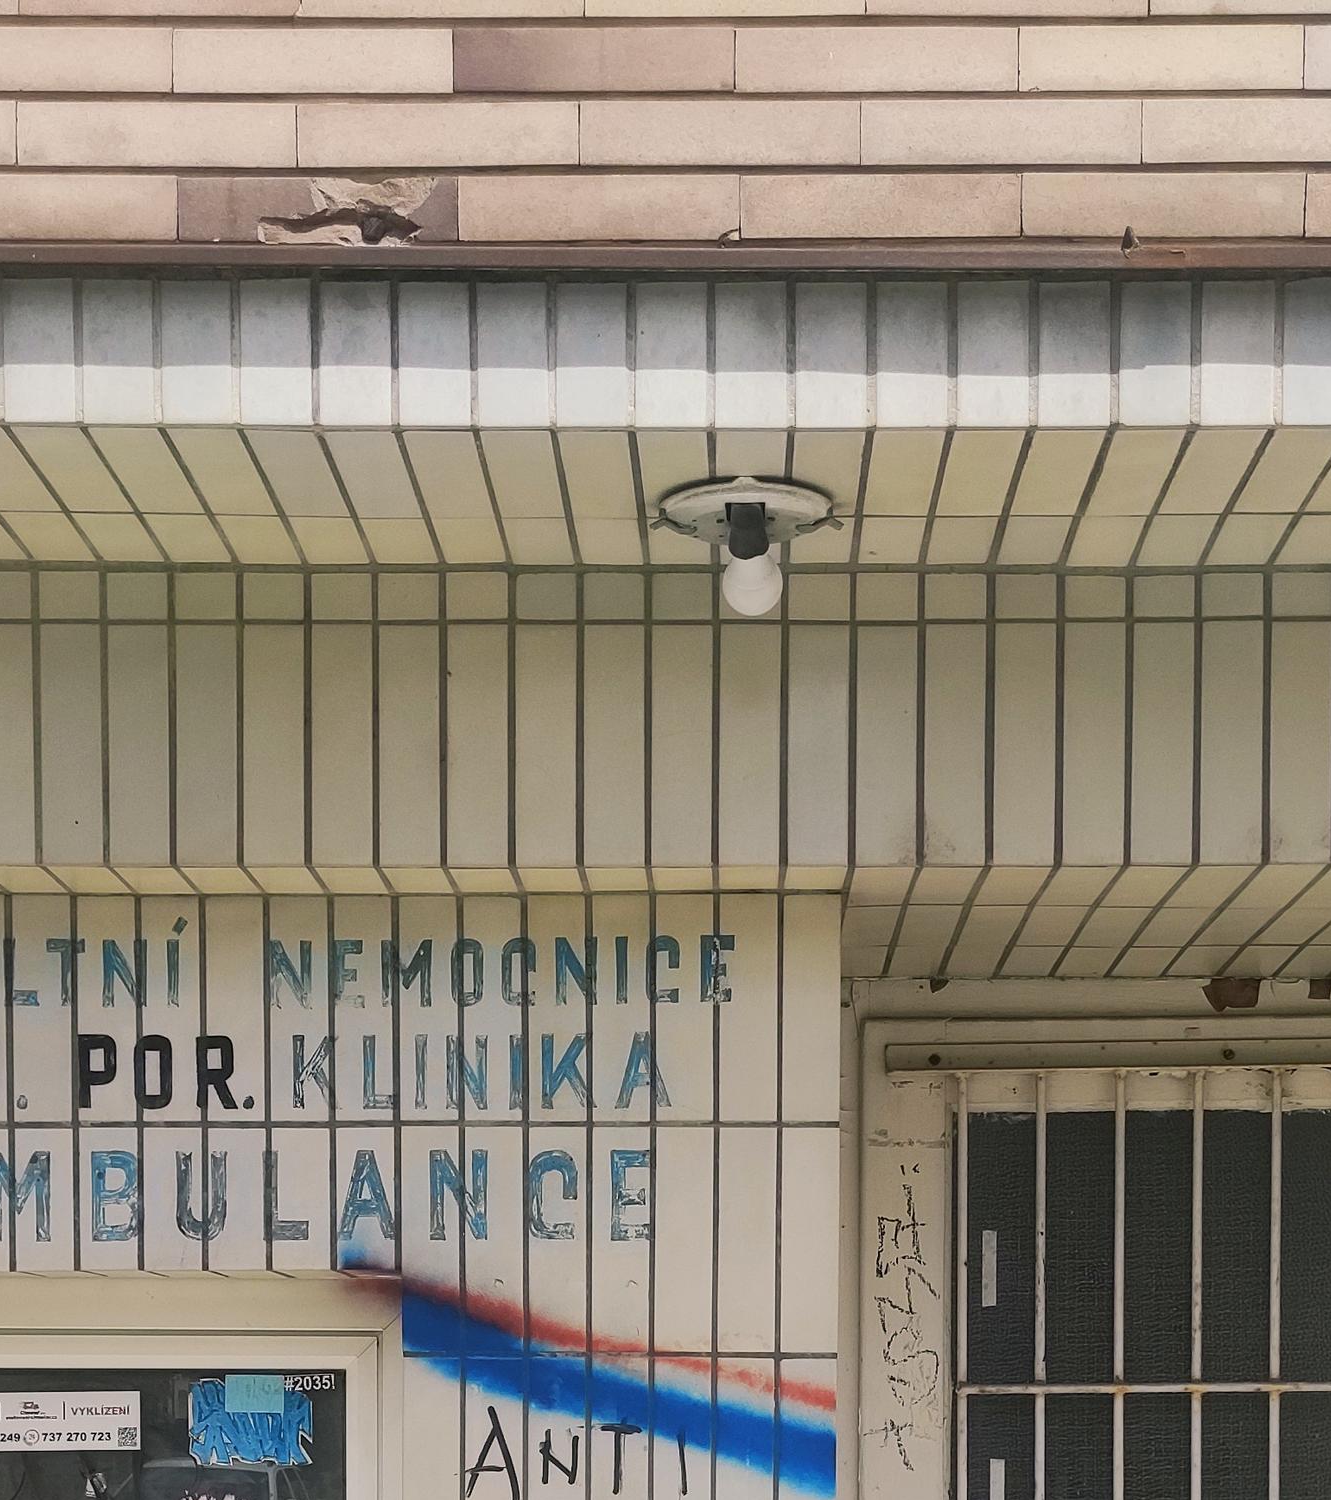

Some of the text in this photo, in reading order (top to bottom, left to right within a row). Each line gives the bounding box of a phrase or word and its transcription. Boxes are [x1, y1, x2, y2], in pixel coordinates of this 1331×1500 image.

[270, 934, 736, 1009] NEMOCNICE
[75, 1033, 256, 1111] POR.
[292, 1031, 672, 1110] KLINIKA
[71, 1404, 131, 1416] VYKLÍZENÍ
[0, 1432, 21, 1442] 249
[41, 1432, 63, 1442] 737
[66, 1432, 87, 1442] 270
[91, 1431, 112, 1442] 723
